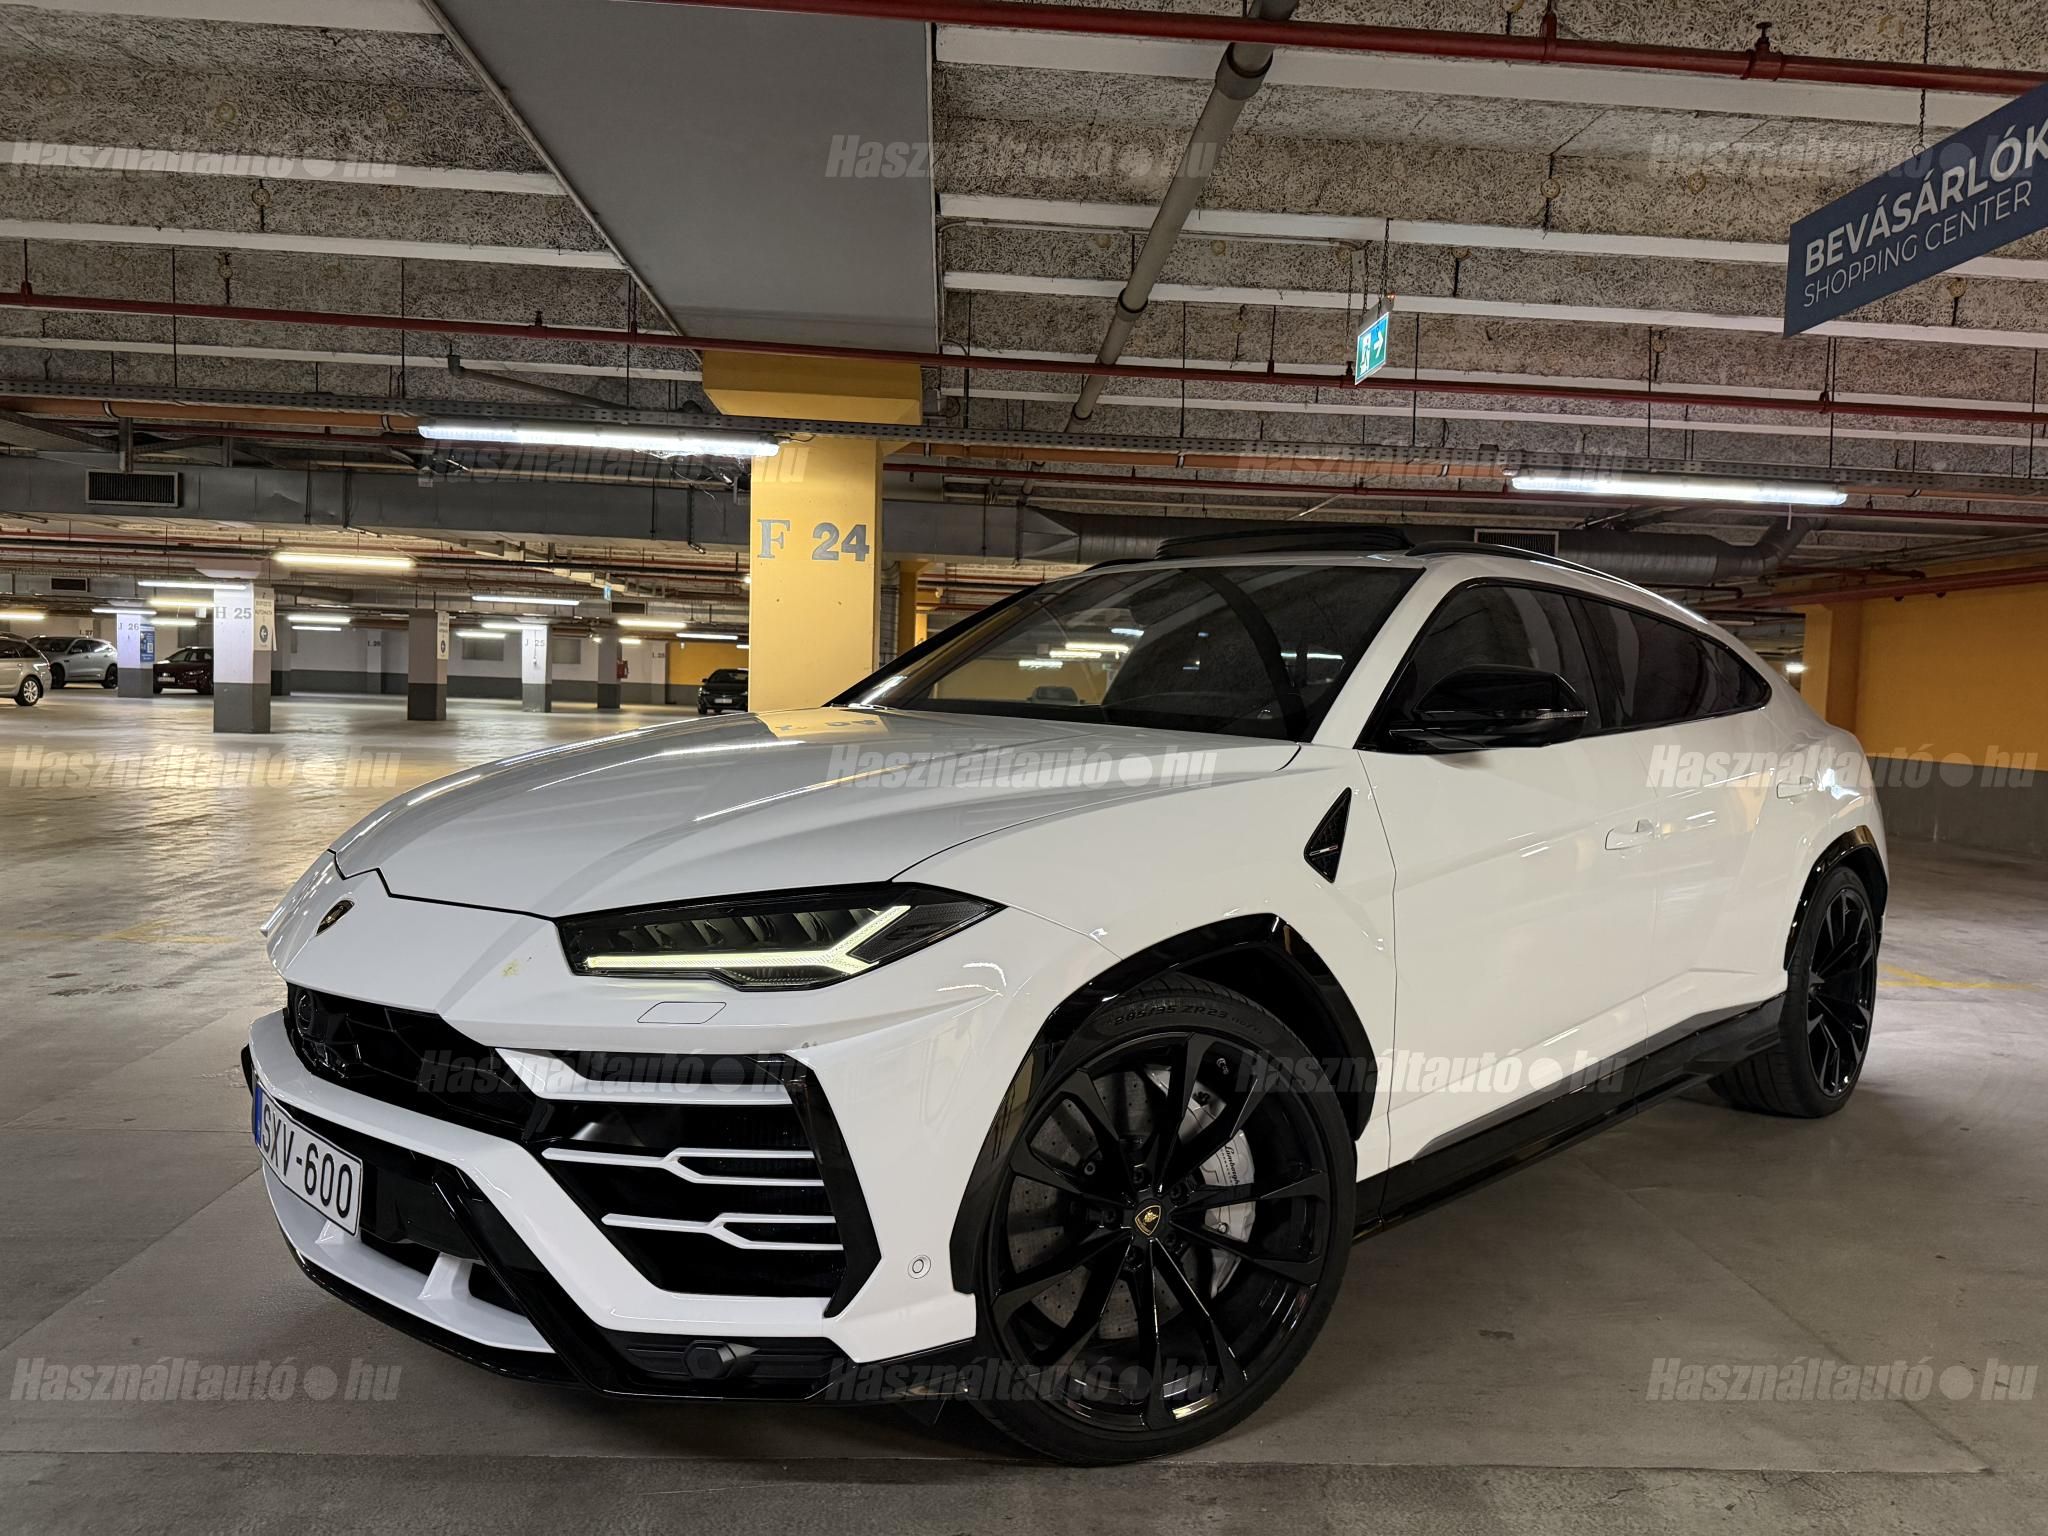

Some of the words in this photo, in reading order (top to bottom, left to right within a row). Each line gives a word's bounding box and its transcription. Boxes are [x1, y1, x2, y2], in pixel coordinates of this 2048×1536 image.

[1803, 234, 1918, 308] SHOPPING
[1924, 180, 2032, 251] CENTER
[757, 519, 791, 558] F
[812, 522, 870, 562] 24
[128, 623, 140, 631] 26
[214, 606, 227, 619] H
[234, 607, 252, 620] 25
[262, 1103, 353, 1219] SXV-600
